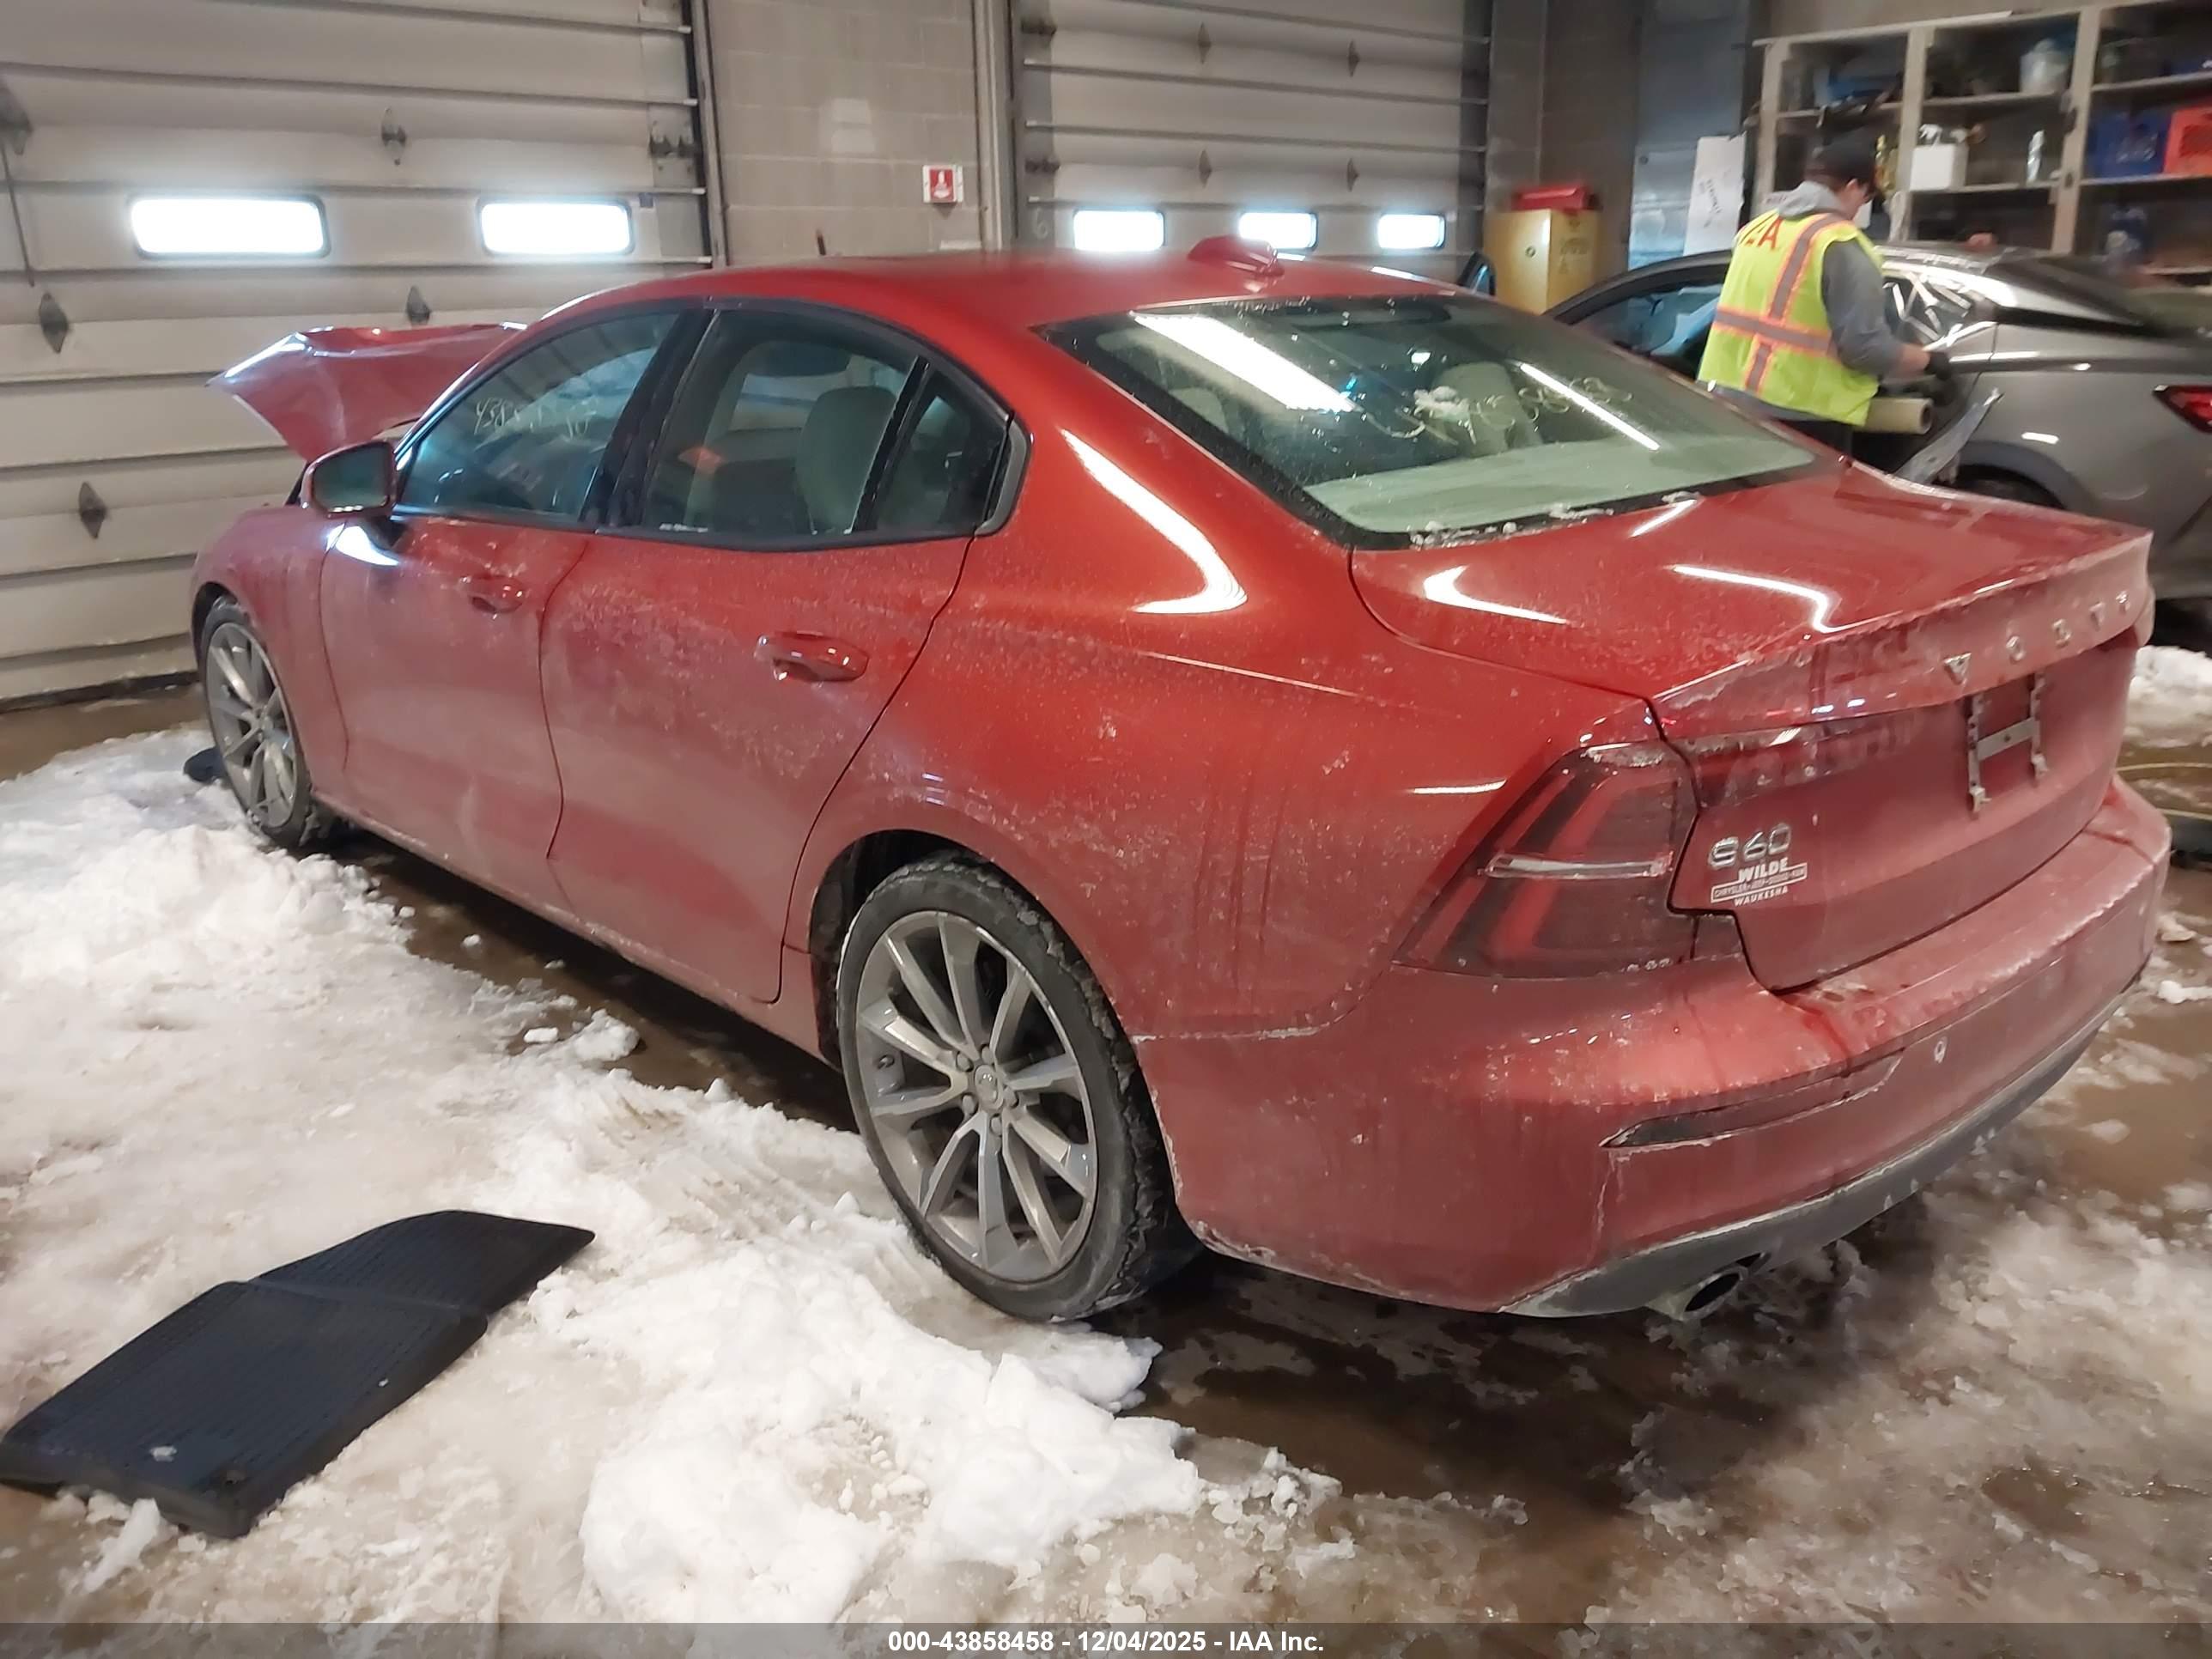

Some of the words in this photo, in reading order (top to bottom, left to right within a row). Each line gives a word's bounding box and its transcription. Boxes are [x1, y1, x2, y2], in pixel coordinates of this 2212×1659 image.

[1943, 591, 2130, 684] VOLVO
[1708, 823, 1791, 868] S60
[1738, 857, 1789, 883] WILDE
[1735, 886, 1789, 906] WAUKESHA
